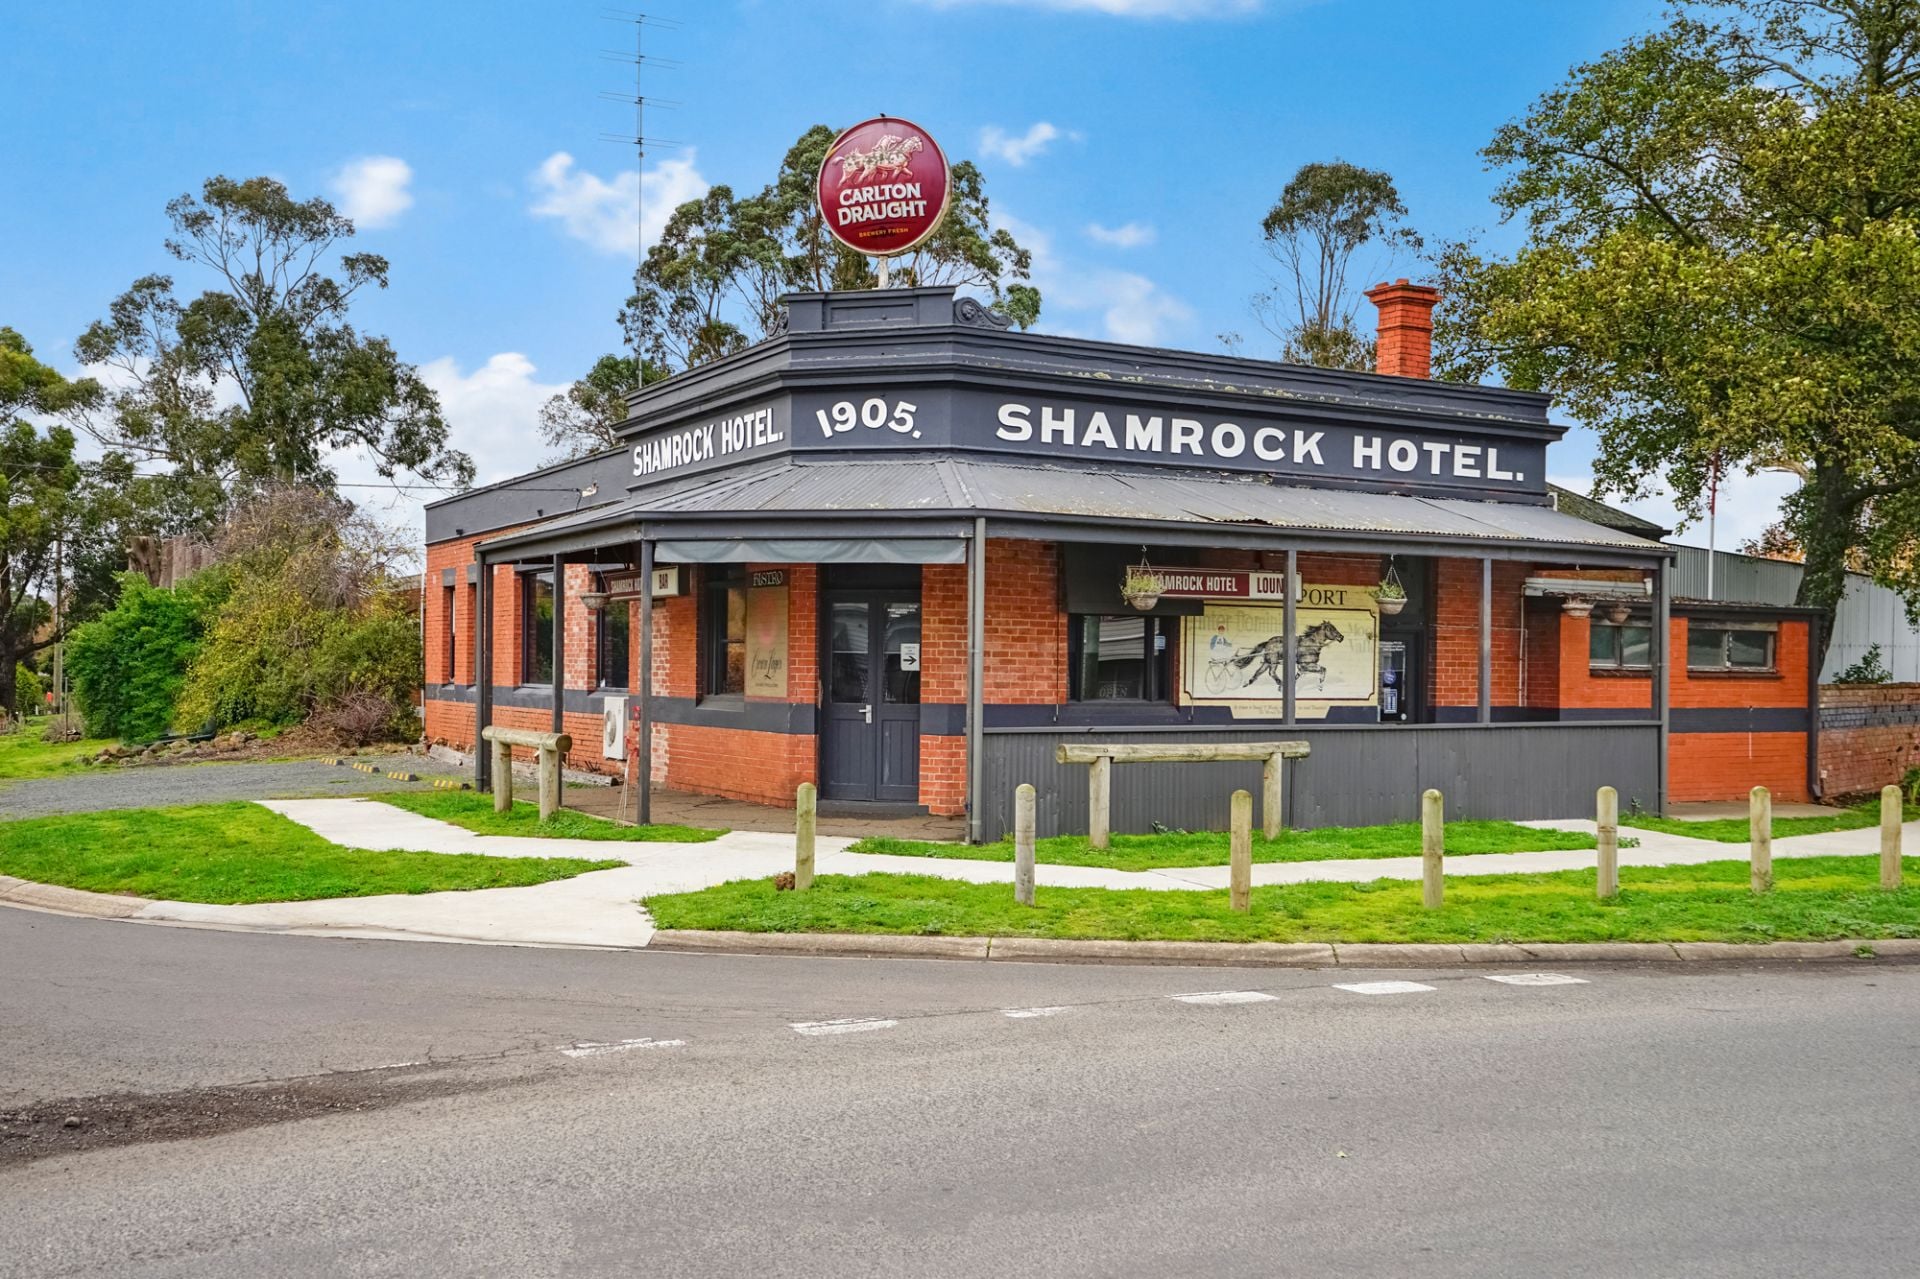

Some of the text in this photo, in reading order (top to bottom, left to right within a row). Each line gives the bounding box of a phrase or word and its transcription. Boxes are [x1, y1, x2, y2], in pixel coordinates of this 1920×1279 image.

[839, 182, 921, 206] CARLTON
[837, 200, 927, 226] DRAUGHT
[858, 229, 886, 238] BREWERY
[816, 398, 922, 440] 1905.
[633, 408, 784, 476] SHAMROCK HOTEL.
[997, 404, 1524, 481] SHAMROCK HOTEL.
[1147, 574, 1237, 592] AMROCK HOTEL
[1257, 577, 1284, 594] LOUN
[1302, 588, 1348, 606] PORT
